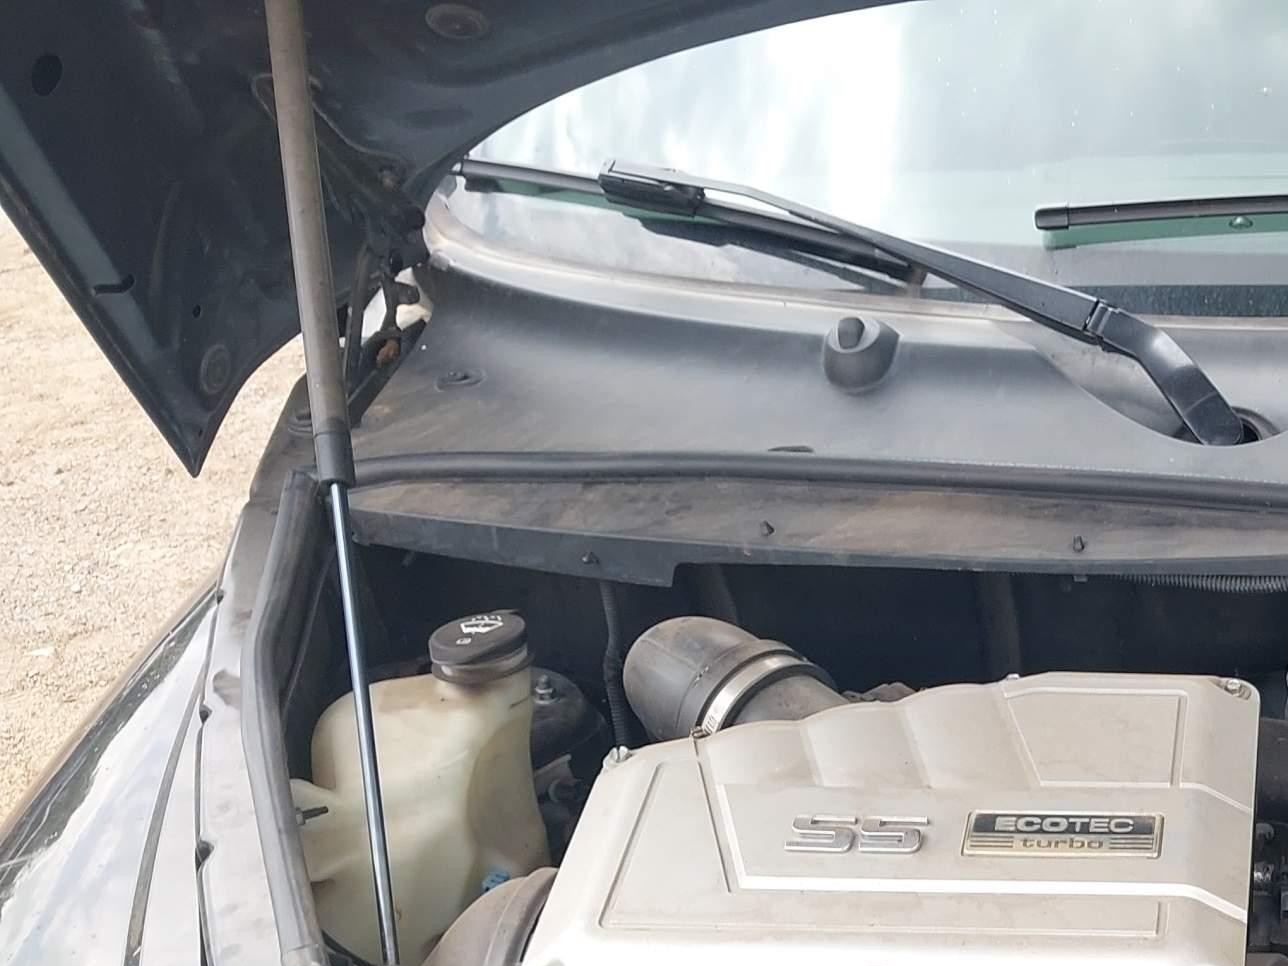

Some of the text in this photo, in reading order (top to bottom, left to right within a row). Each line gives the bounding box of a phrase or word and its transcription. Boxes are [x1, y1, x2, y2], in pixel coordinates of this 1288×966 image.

[994, 816, 1135, 834] ECOTEC
[784, 815, 932, 854] SS
[1019, 836, 1105, 850] turbo
